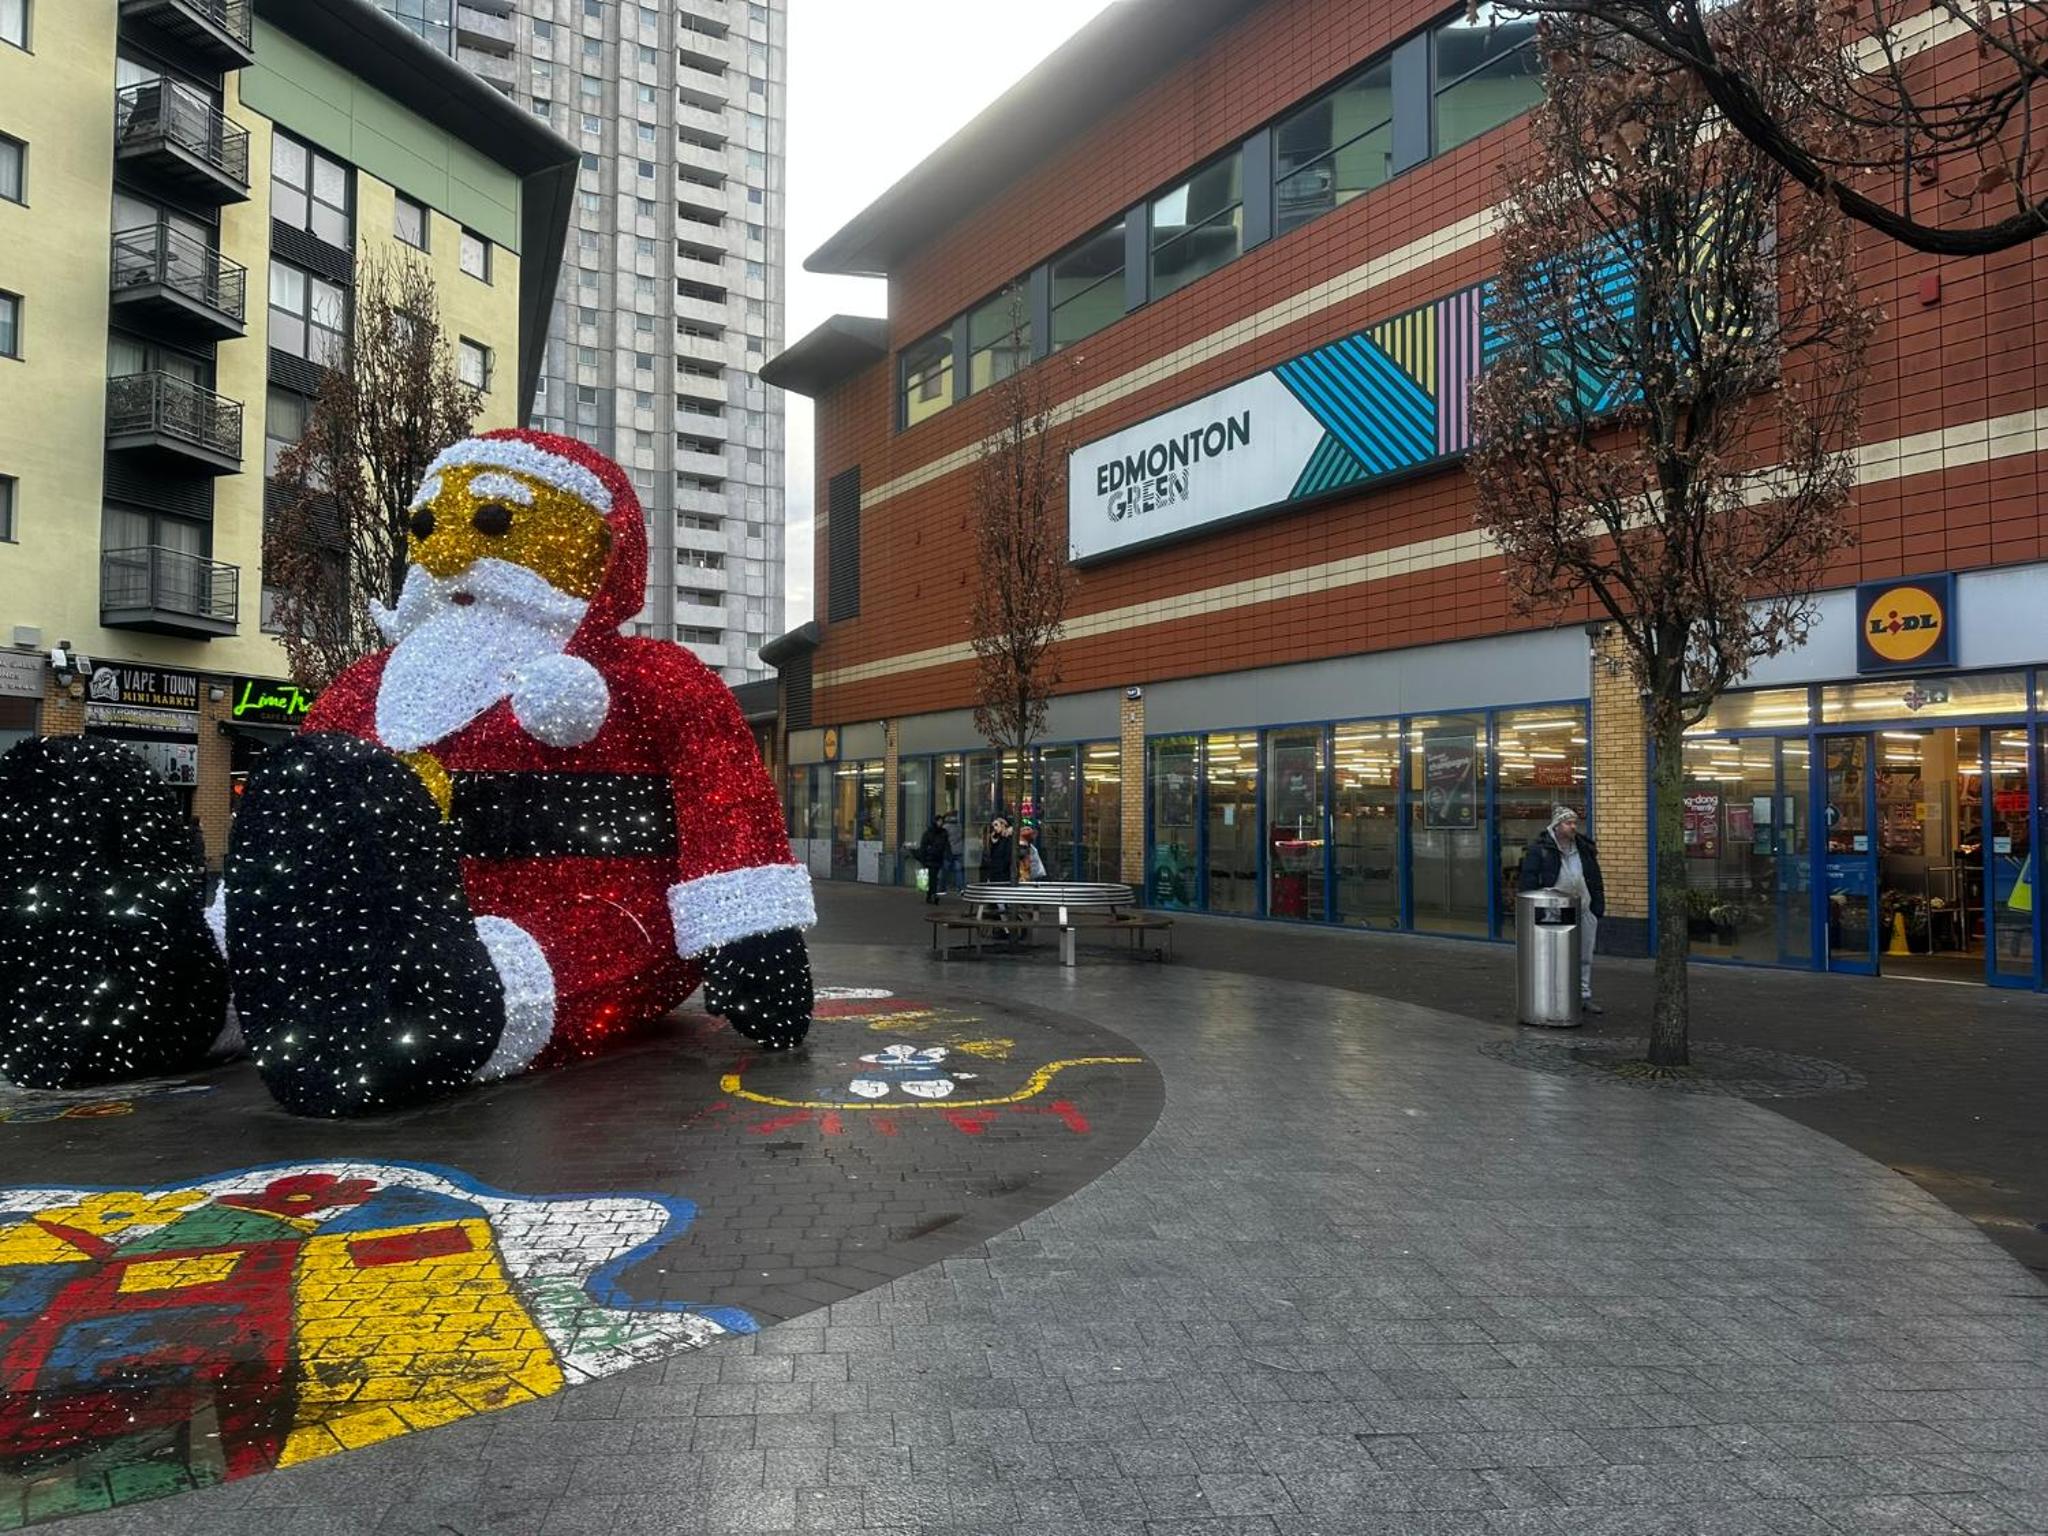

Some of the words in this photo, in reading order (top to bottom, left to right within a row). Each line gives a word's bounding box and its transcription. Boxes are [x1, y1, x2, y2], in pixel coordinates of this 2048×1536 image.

[1097, 410, 1251, 497] EDMONTON
[1107, 467, 1190, 523] GREEN
[122, 691, 150, 703] MINI
[153, 694, 197, 707] MARKET
[123, 669, 157, 693] VAPE
[162, 674, 197, 697] TOWN
[233, 681, 287, 716] Lime
[277, 686, 313, 715] Tr
